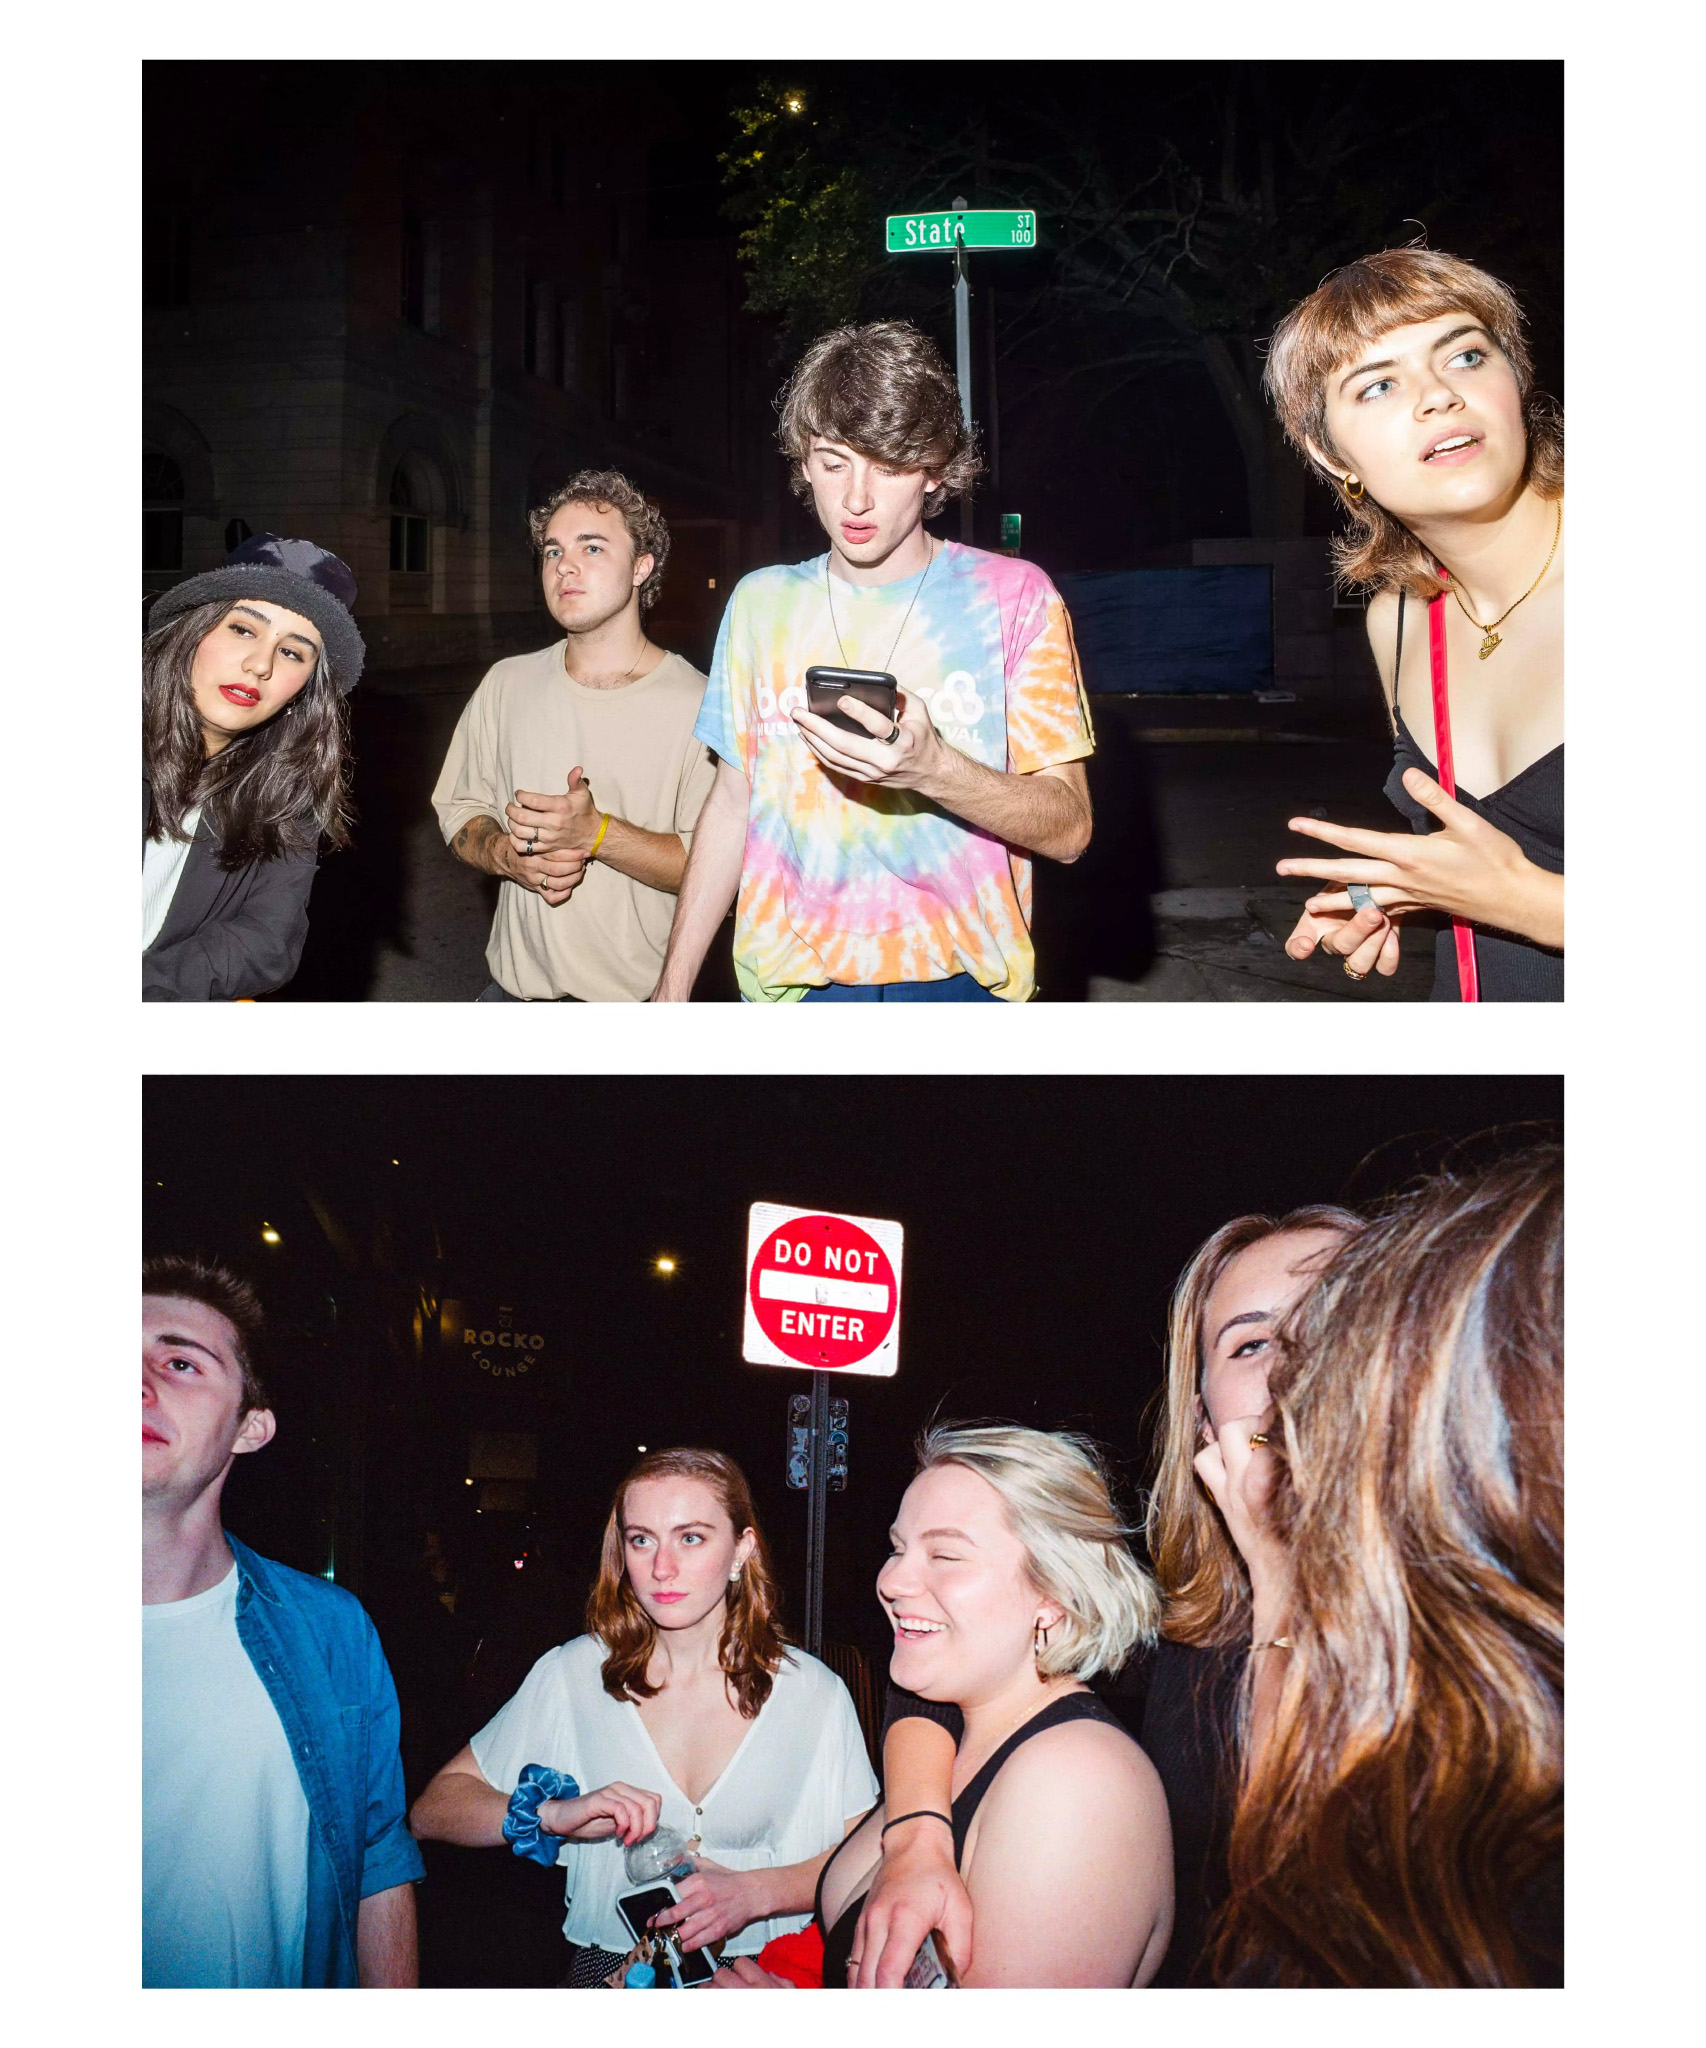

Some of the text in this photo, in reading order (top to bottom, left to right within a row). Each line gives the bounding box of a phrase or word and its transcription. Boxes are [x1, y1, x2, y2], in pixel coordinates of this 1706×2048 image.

[905, 217, 965, 245] State
[1017, 215, 1031, 228] ST
[1011, 230, 1031, 243] 100
[774, 1238, 879, 1275] DO NOT
[463, 1328, 545, 1350] ROCKO
[781, 1309, 865, 1343] ENTER
[471, 1350, 536, 1378] LOUNGE
